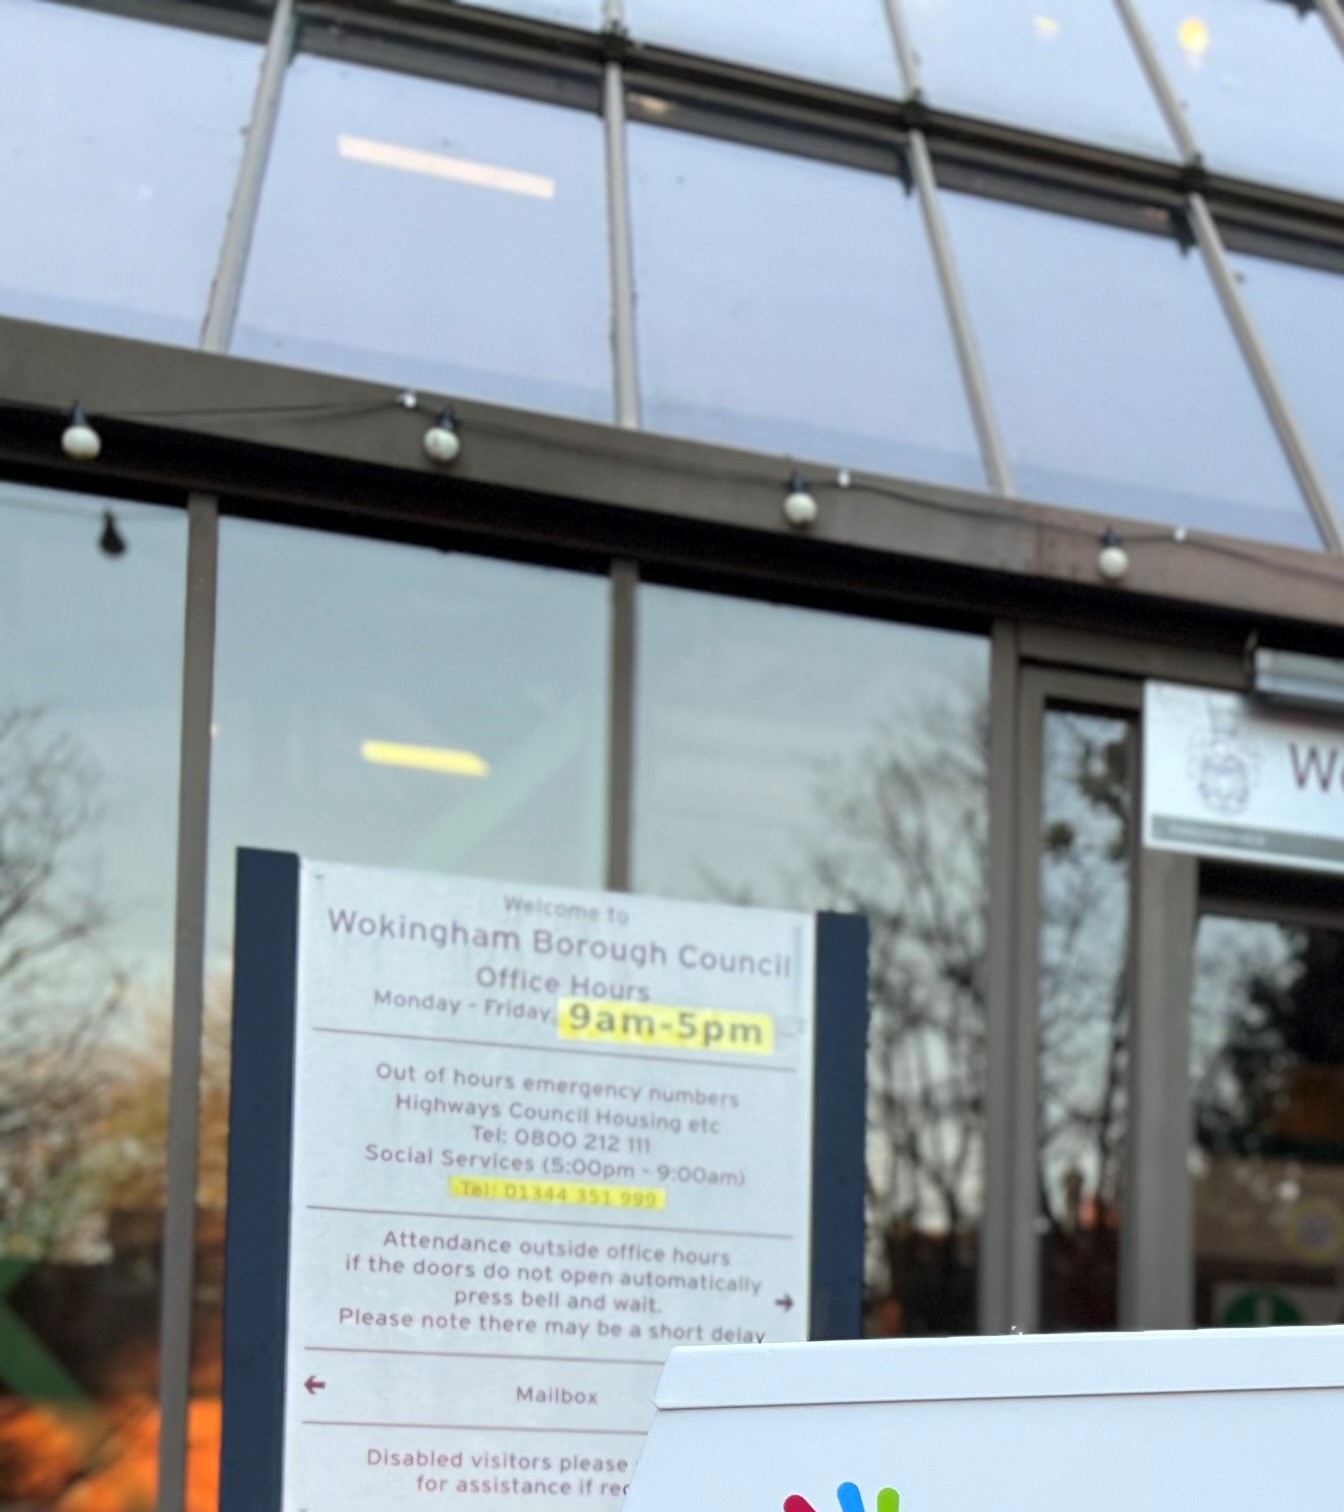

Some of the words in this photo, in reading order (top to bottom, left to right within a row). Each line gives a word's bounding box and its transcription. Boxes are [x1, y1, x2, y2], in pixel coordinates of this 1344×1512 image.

[503, 895, 600, 923] Welcome
[605, 908, 629, 925] to
[328, 907, 521, 950] Wokingham
[533, 929, 668, 968] Borough
[679, 944, 791, 978] Council
[476, 965, 560, 995] Office
[571, 975, 650, 1002] Hours
[373, 989, 462, 1016] Monday
[570, 1002, 762, 1046] 9am-5pm
[376, 1062, 417, 1083] Out
[424, 1065, 447, 1084] of
[454, 1068, 515, 1090] hours
[523, 1076, 642, 1101] emergency
[649, 1083, 739, 1108] numbers
[395, 1093, 502, 1119] Highways
[509, 1101, 590, 1124] Council
[597, 1107, 682, 1135] Housing
[688, 1115, 721, 1134] etc
[471, 1125, 508, 1144] Tel:
[514, 1128, 577, 1149] 0800
[584, 1134, 620, 1152] 212
[365, 1144, 434, 1165] Social
[441, 1149, 536, 1172] Services
[542, 1154, 634, 1182] (5:00pm
[656, 1164, 746, 1188] 9:00am)
[460, 1180, 498, 1198] Tel:
[383, 1230, 511, 1255] Attendance
[519, 1239, 599, 1259] outside
[607, 1242, 665, 1263] office
[673, 1246, 731, 1266] hours
[344, 1255, 361, 1271] if
[368, 1256, 405, 1275] the
[412, 1258, 476, 1278] doors
[484, 1261, 510, 1279] do
[516, 1264, 553, 1282] not
[560, 1268, 613, 1288] open
[620, 1269, 762, 1296] automatically
[454, 1288, 514, 1308] press
[521, 1288, 560, 1308] bell
[566, 1292, 606, 1310] and
[612, 1295, 662, 1313] wait.
[338, 1308, 413, 1328] Please
[421, 1313, 471, 1330] note
[478, 1314, 538, 1333] there
[545, 1321, 589, 1339] may
[596, 1320, 623, 1338] be
[628, 1325, 641, 1339] a
[648, 1322, 702, 1341] short
[710, 1326, 766, 1345] delay
[515, 1386, 598, 1405] Mailbox
[366, 1448, 463, 1468] Disabled
[471, 1450, 552, 1471] visitors
[559, 1454, 628, 1475] please
[417, 1475, 448, 1493] for
[455, 1476, 572, 1495] assistance
[578, 1477, 592, 1496] if
